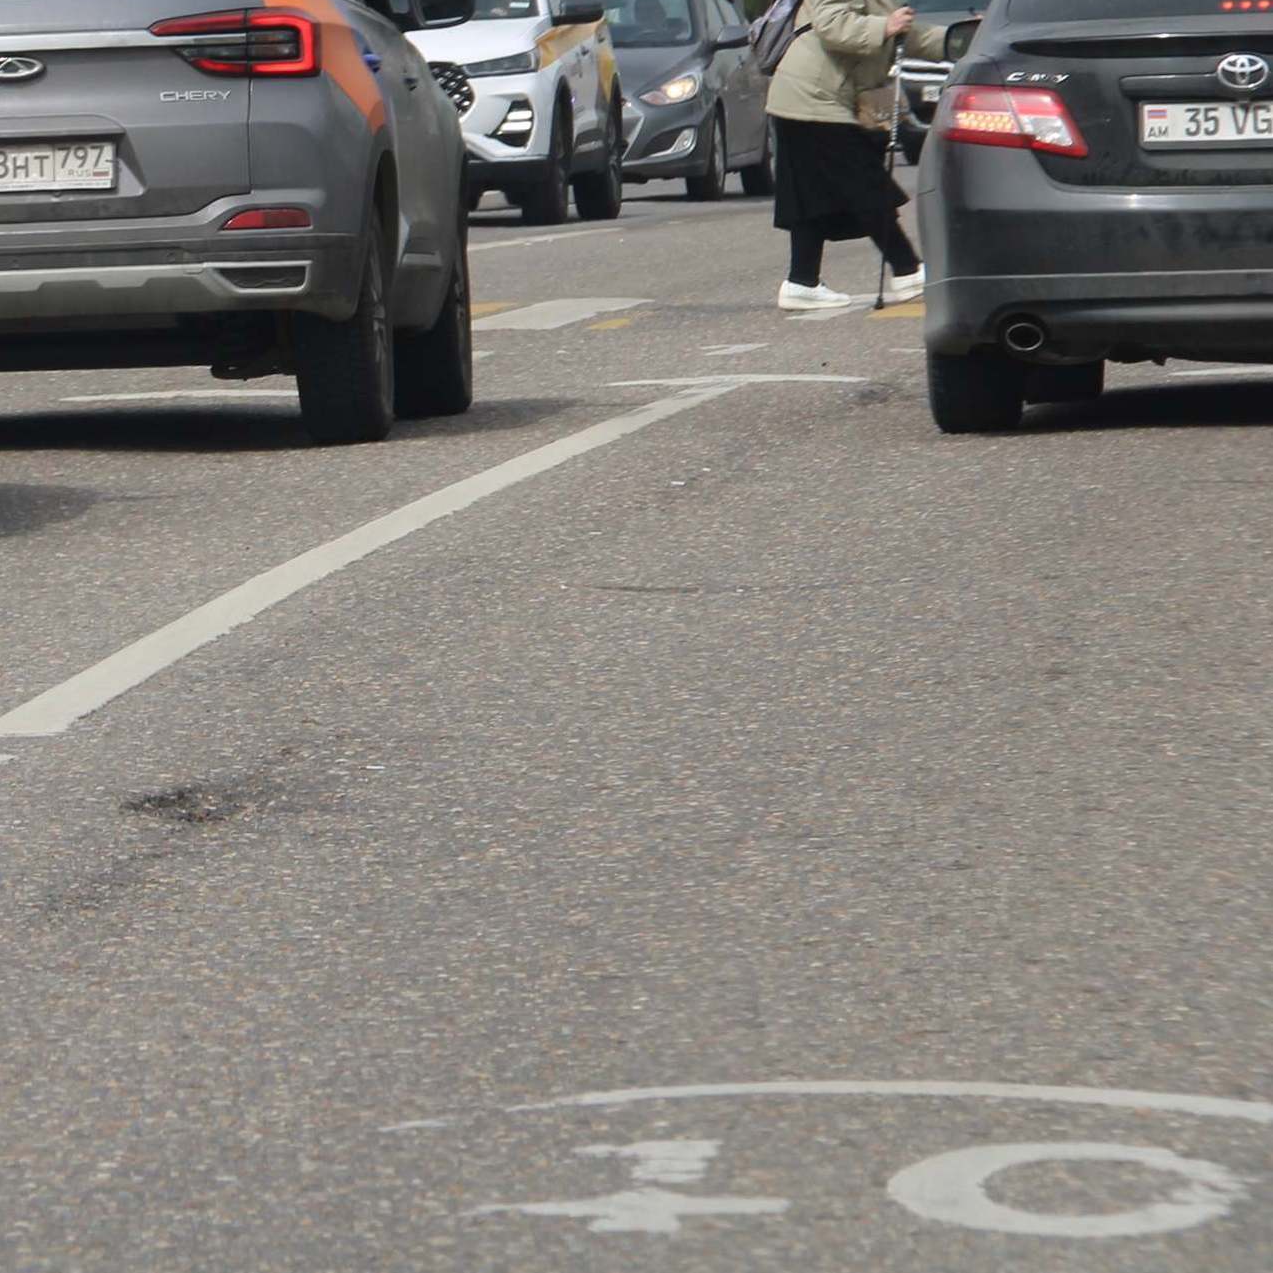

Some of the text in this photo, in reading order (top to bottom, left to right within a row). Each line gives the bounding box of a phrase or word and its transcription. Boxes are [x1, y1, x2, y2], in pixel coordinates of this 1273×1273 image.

[159, 89, 232, 102] CHERY
[1147, 125, 1169, 138] AM
[1184, 107, 1220, 136] 35
[56, 145, 105, 169] 797
